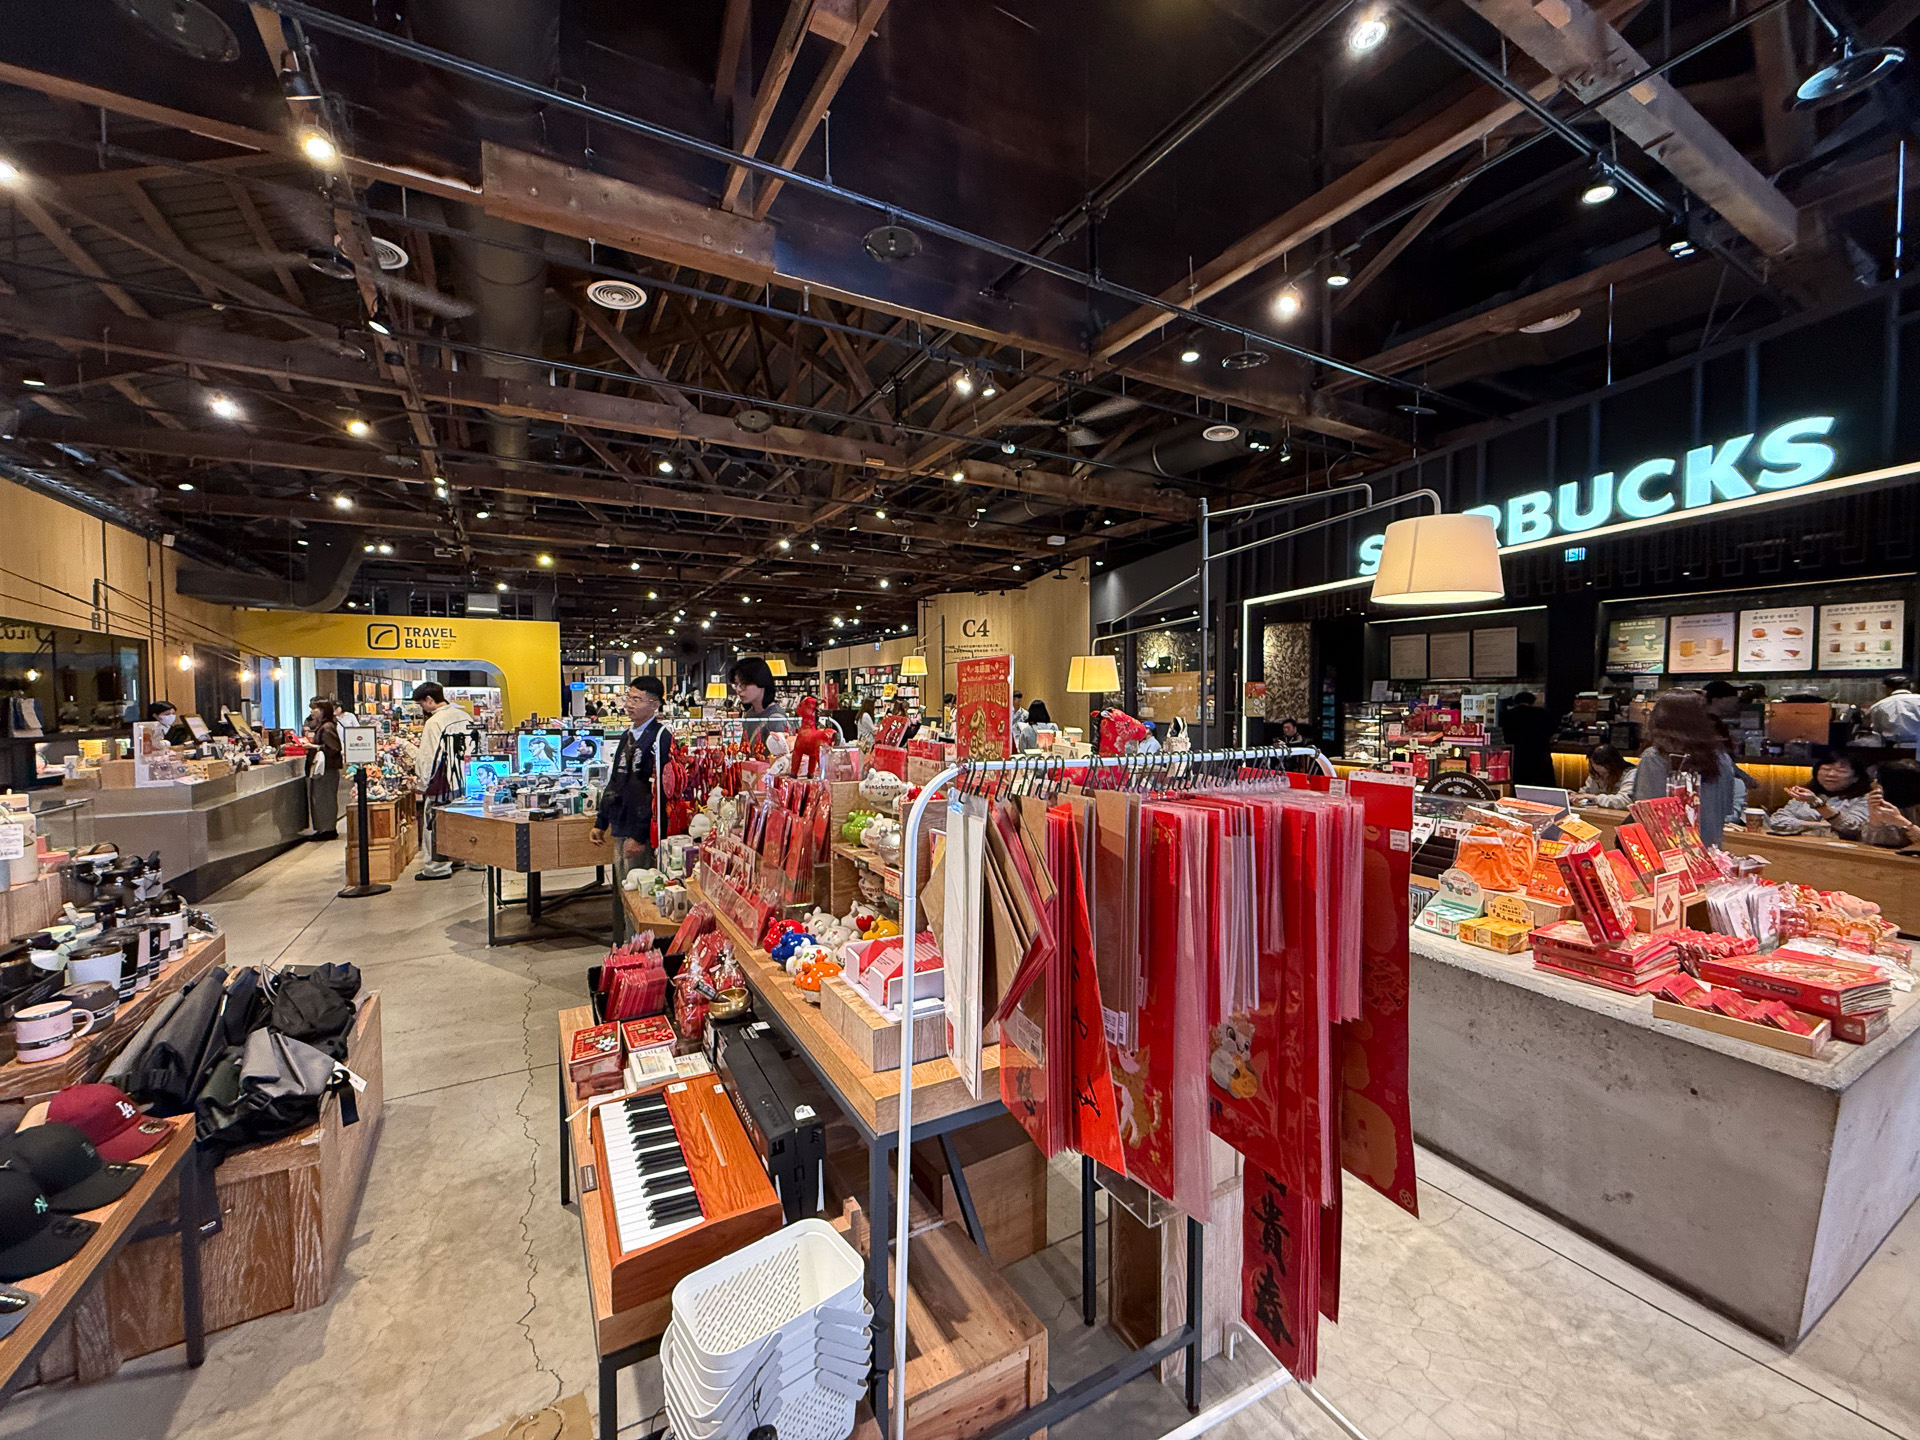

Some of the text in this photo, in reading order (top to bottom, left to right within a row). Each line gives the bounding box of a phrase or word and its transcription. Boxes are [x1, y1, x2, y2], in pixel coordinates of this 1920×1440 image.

[1358, 416, 1836, 575] SBUCKS
[404, 627, 457, 638] TRAVEL
[962, 619, 990, 637] C4
[405, 638, 440, 649] BLUE
[115, 1101, 136, 1119] LA
